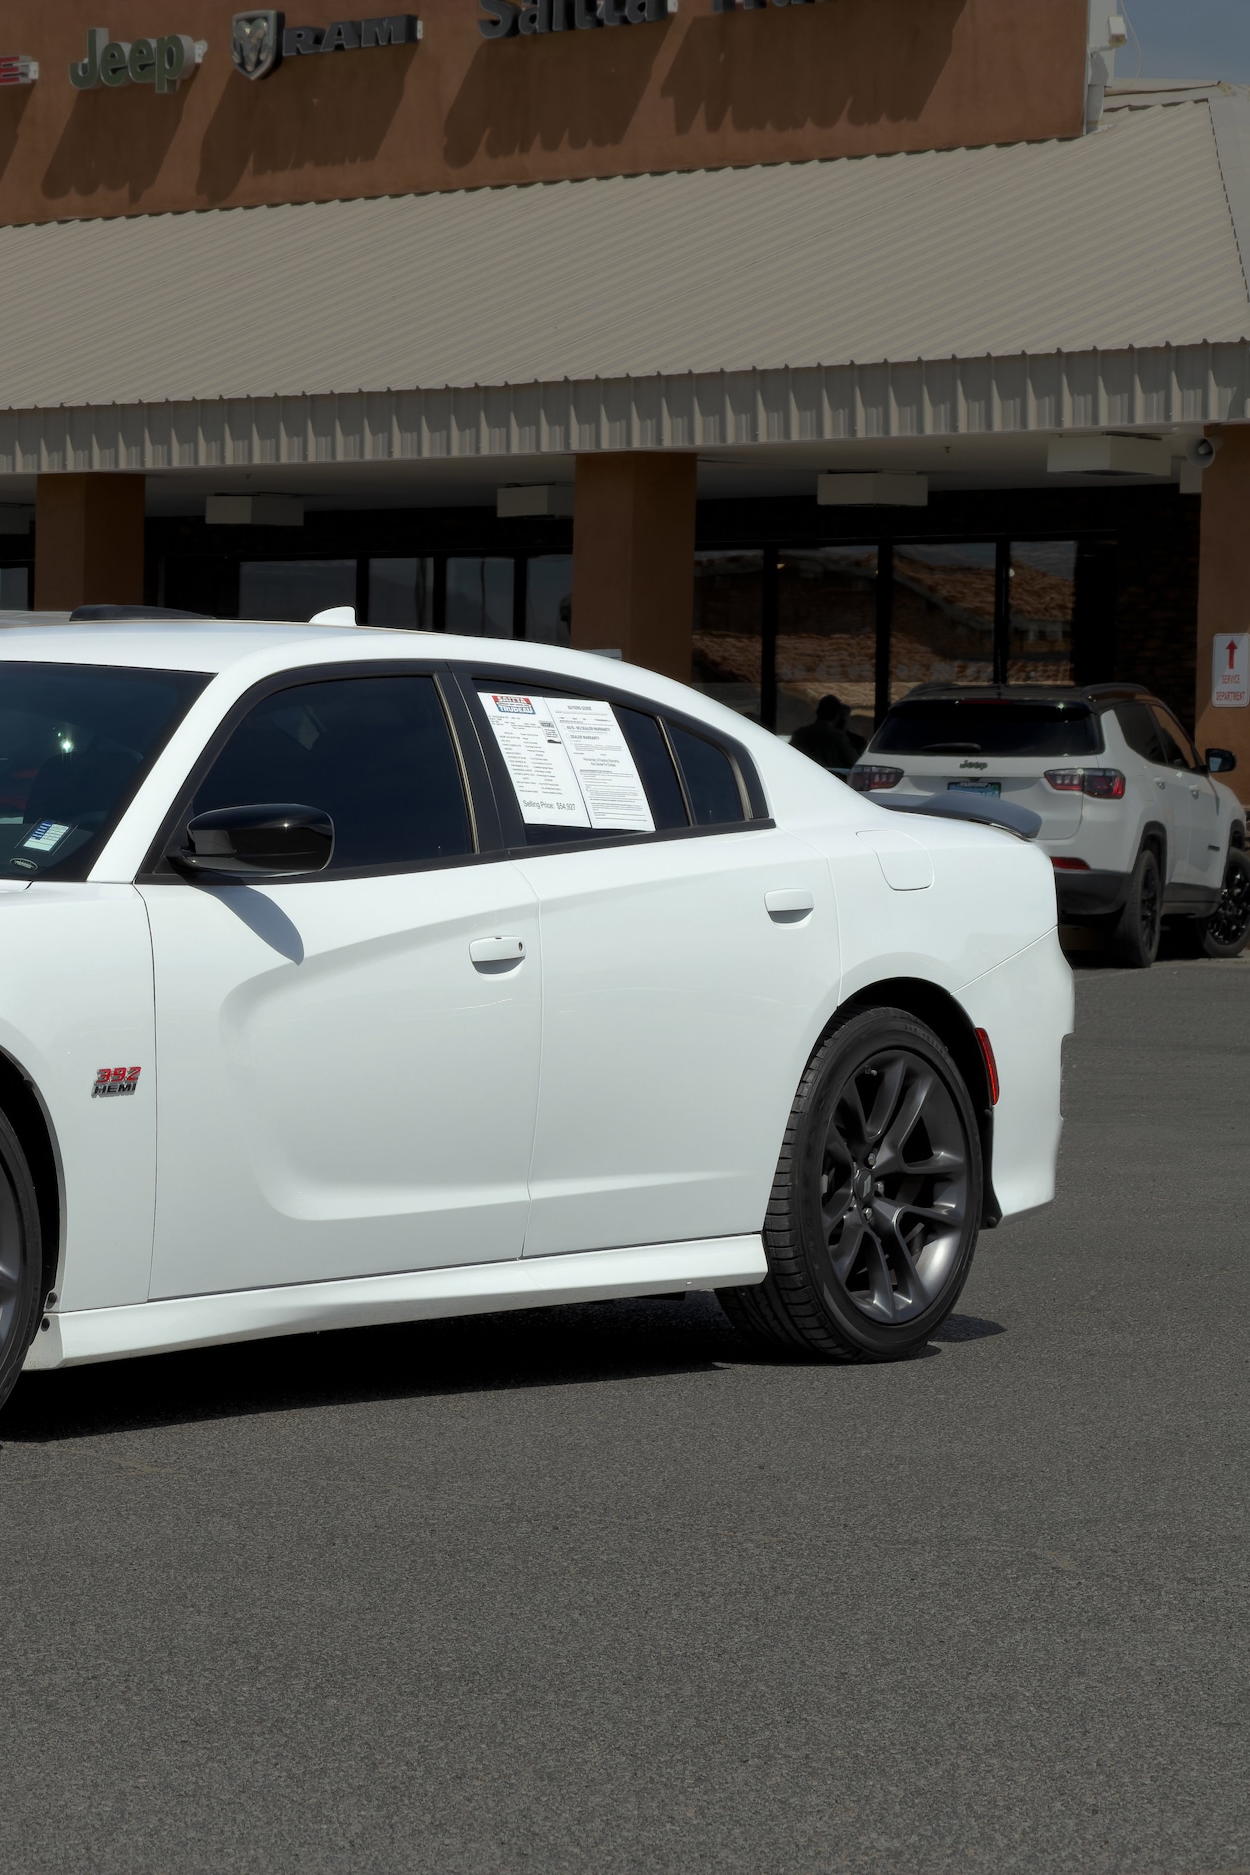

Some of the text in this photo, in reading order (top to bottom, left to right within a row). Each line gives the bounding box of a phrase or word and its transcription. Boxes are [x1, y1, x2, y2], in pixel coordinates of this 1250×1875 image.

[282, 16, 416, 57] RAM
[70, 28, 193, 93] Jeep
[1221, 674, 1240, 685] SERVICE
[1215, 691, 1246, 701] DEPARTMENT
[499, 705, 533, 714] TRUDEAU
[959, 760, 988, 771] Jeep
[523, 799, 540, 810] Selling
[540, 801, 555, 810] Price:
[96, 1067, 141, 1084] 392
[92, 1082, 137, 1098] HEMI
